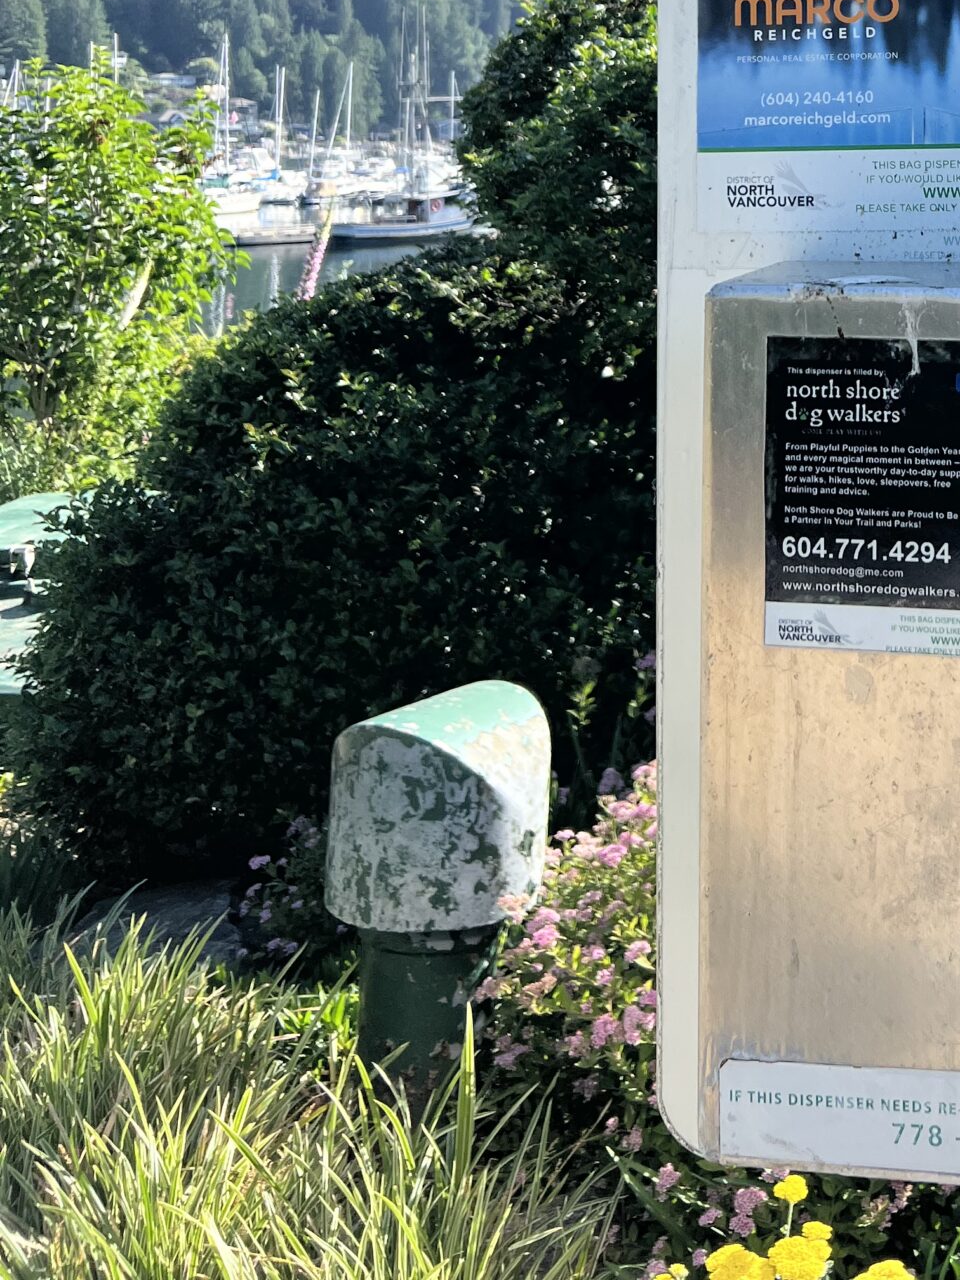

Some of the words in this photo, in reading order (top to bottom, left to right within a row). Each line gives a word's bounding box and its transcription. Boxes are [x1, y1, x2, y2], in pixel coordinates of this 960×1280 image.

[754, 26, 876, 42] REICHGELD
[736, 54, 780, 64] PERSONAL
[783, 53, 802, 62] REAL
[805, 52, 835, 62] ESTATE
[837, 51, 899, 62] CORPORATION
[760, 91, 799, 108] (604)
[803, 90, 874, 105] 240-4160
[744, 111, 891, 128] marcoreichgeld.com
[872, 160, 896, 170] THIS
[899, 160, 921, 169] BAG
[727, 176, 761, 184] DISTRICT
[866, 175, 876, 184] IF
[879, 174, 900, 183] YOU
[904, 174, 944, 184] WOULD
[727, 184, 774, 196] NORTH
[727, 195, 815, 208] VANCOUVER
[787, 366, 803, 375] This
[805, 367, 843, 376] dispenser
[853, 368, 872, 376] filled
[786, 378, 841, 399] north
[846, 380, 900, 400] shore
[827, 403, 901, 423] walkers
[785, 442, 808, 451] From
[810, 442, 840, 453] Playful
[842, 444, 878, 454] Puppies
[880, 445, 889, 453] to
[891, 445, 905, 453] the
[907, 445, 940, 455] Golden
[785, 464, 797, 472] we
[815, 465, 835, 474] your
[837, 466, 888, 476] trustworthy
[890, 467, 937, 478] day-to-day
[784, 505, 807, 514] North
[809, 506, 834, 515] Shore
[836, 506, 854, 517] Dog
[855, 507, 889, 517] Walkers
[891, 510, 906, 518] are
[907, 509, 934, 519] Proud
[935, 511, 944, 519] to
[946, 511, 959, 520] Be
[791, 515, 821, 525] Partner
[834, 517, 853, 526] Your
[855, 518, 874, 527] Trail
[876, 519, 892, 528] and
[894, 520, 922, 529] Parks!
[782, 535, 951, 564] 604.771.4294
[782, 564, 904, 578] northshoredog@me.com
[778, 624, 813, 634] NORTH
[779, 633, 841, 644] VANCOUVER
[729, 1089, 742, 1103] IF
[747, 1090, 782, 1105] THIS
[788, 1093, 875, 1111] DISPENSER
[881, 1098, 932, 1114] NEEDS
[891, 1122, 943, 1148] 778
